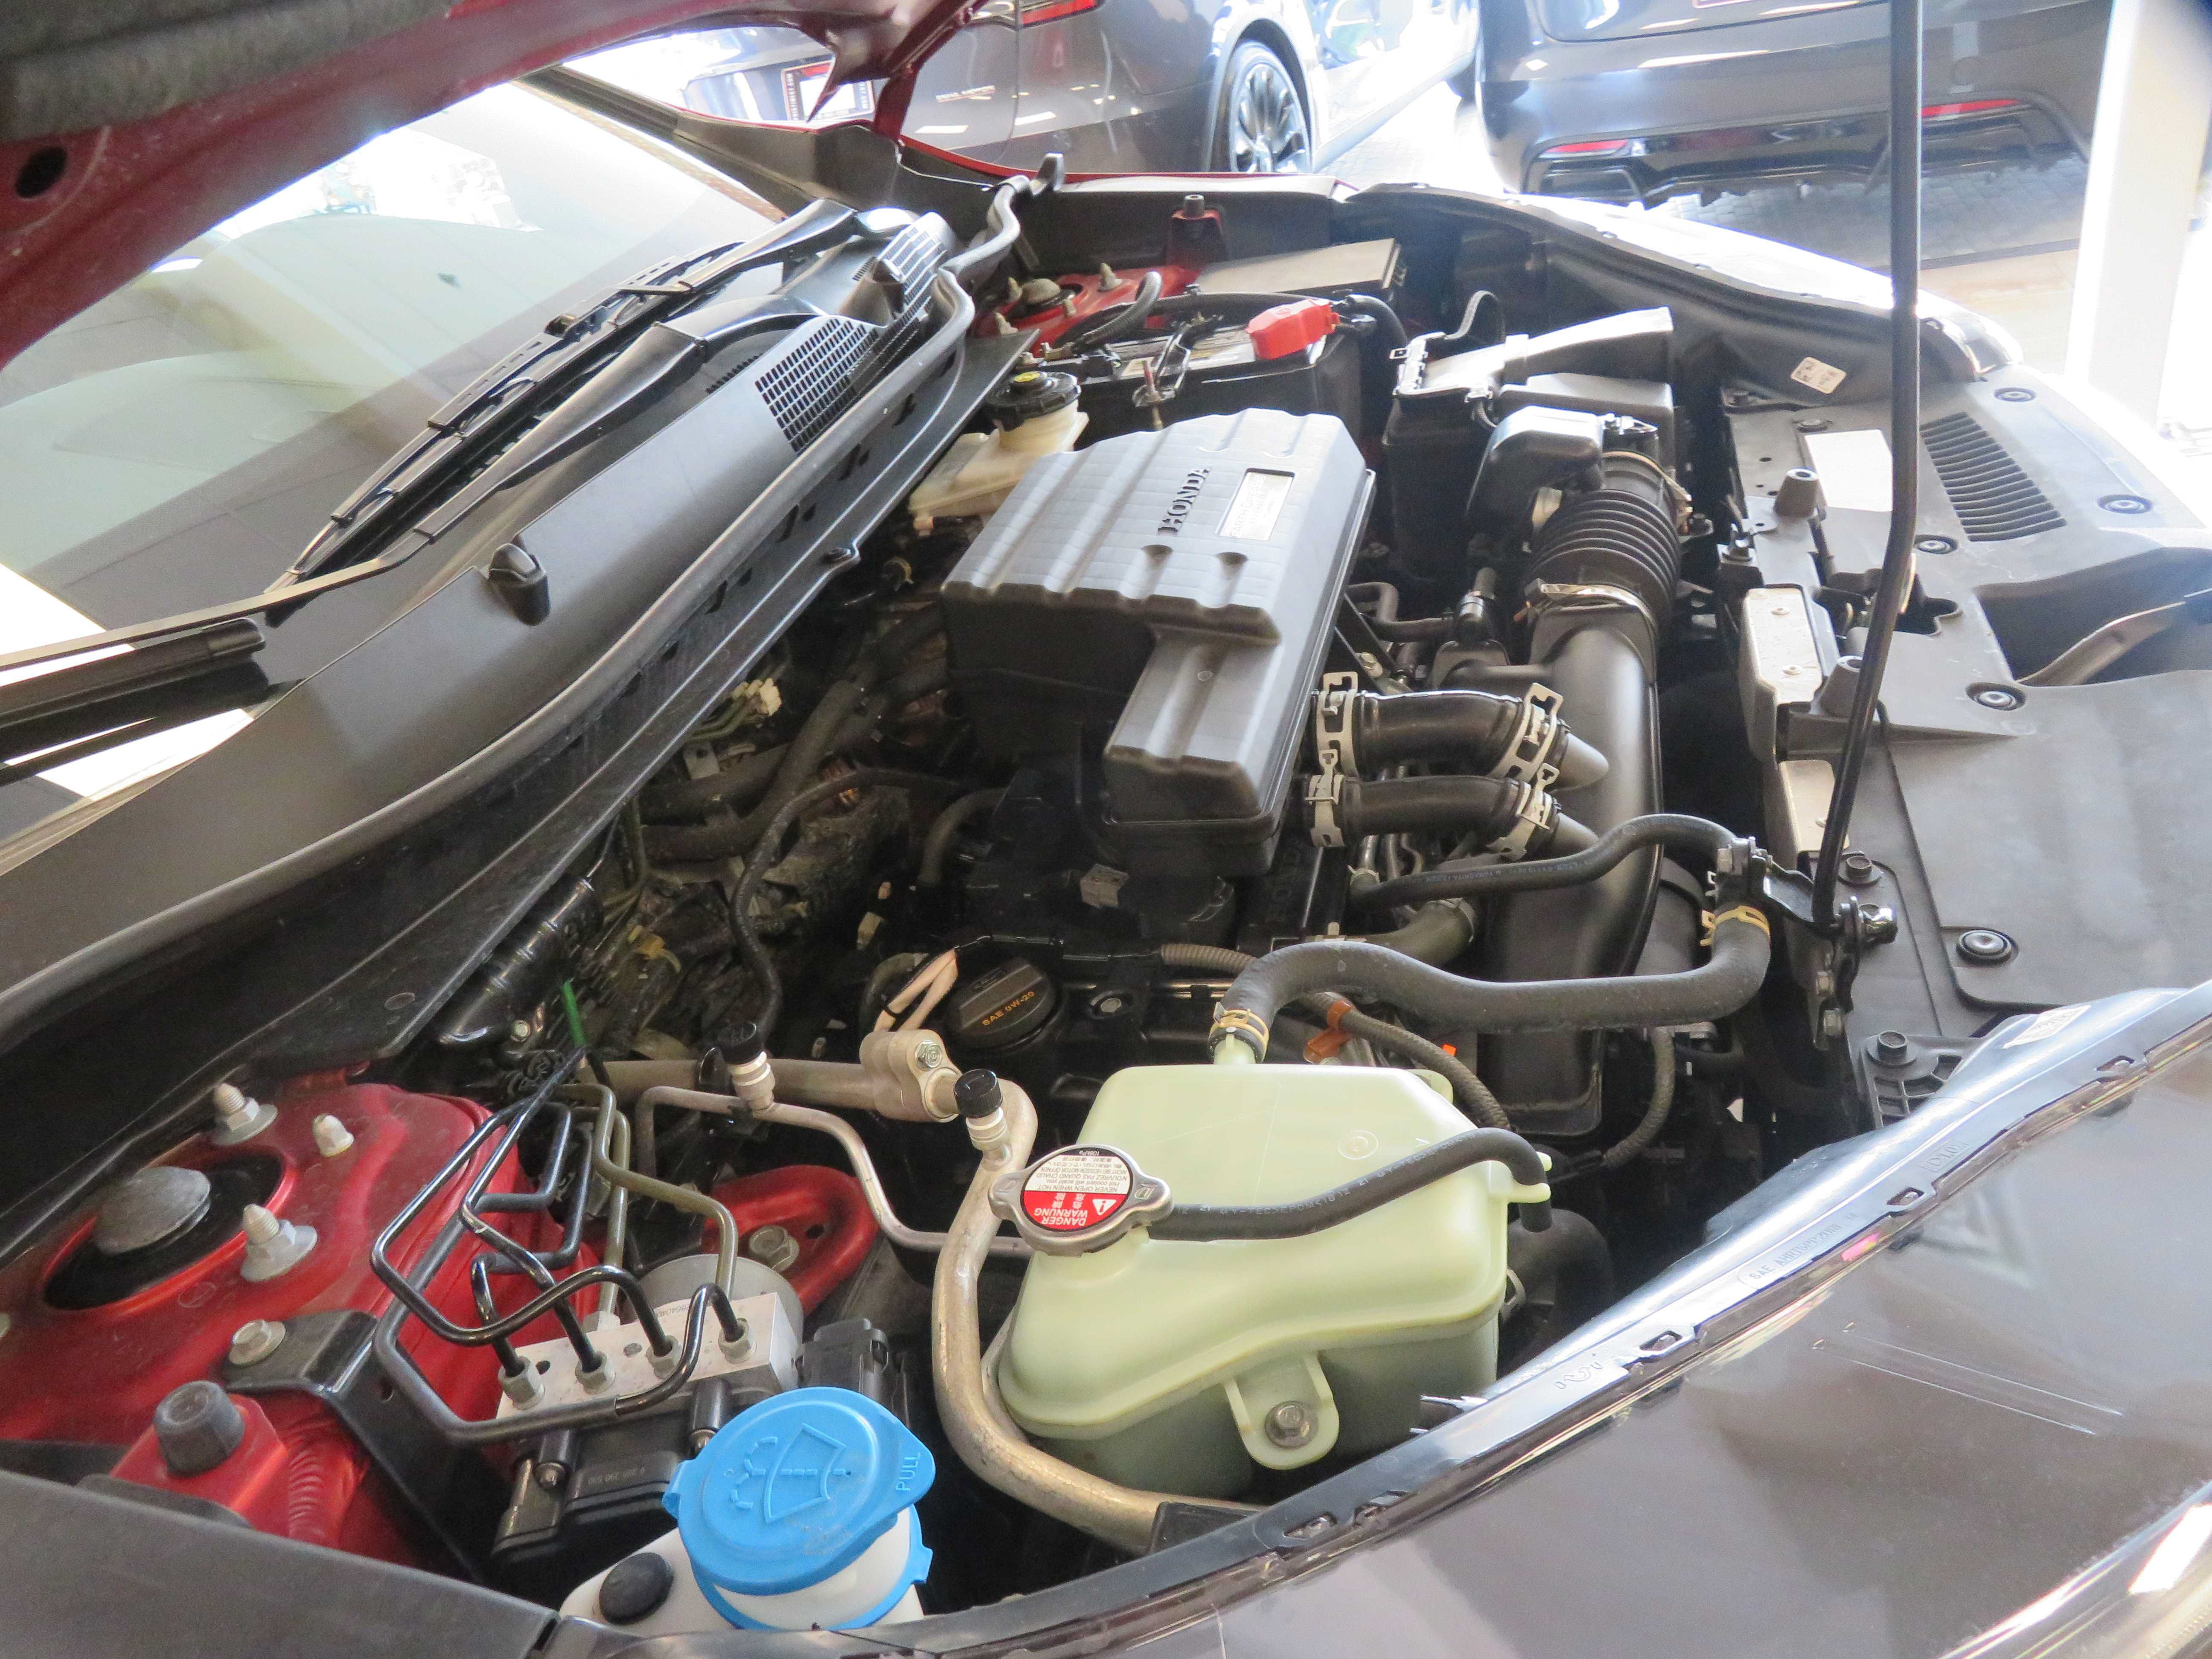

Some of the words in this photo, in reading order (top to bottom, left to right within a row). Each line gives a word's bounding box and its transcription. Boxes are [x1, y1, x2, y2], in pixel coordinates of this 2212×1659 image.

[1158, 467, 1211, 536] HONDA
[981, 1010, 1004, 1026] SAE
[1004, 991, 1035, 1011] 0W-20
[1034, 1208, 1088, 1218] WARNUNG
[1041, 1216, 1086, 1226] DANGER
[895, 1452, 921, 1492] PULL
